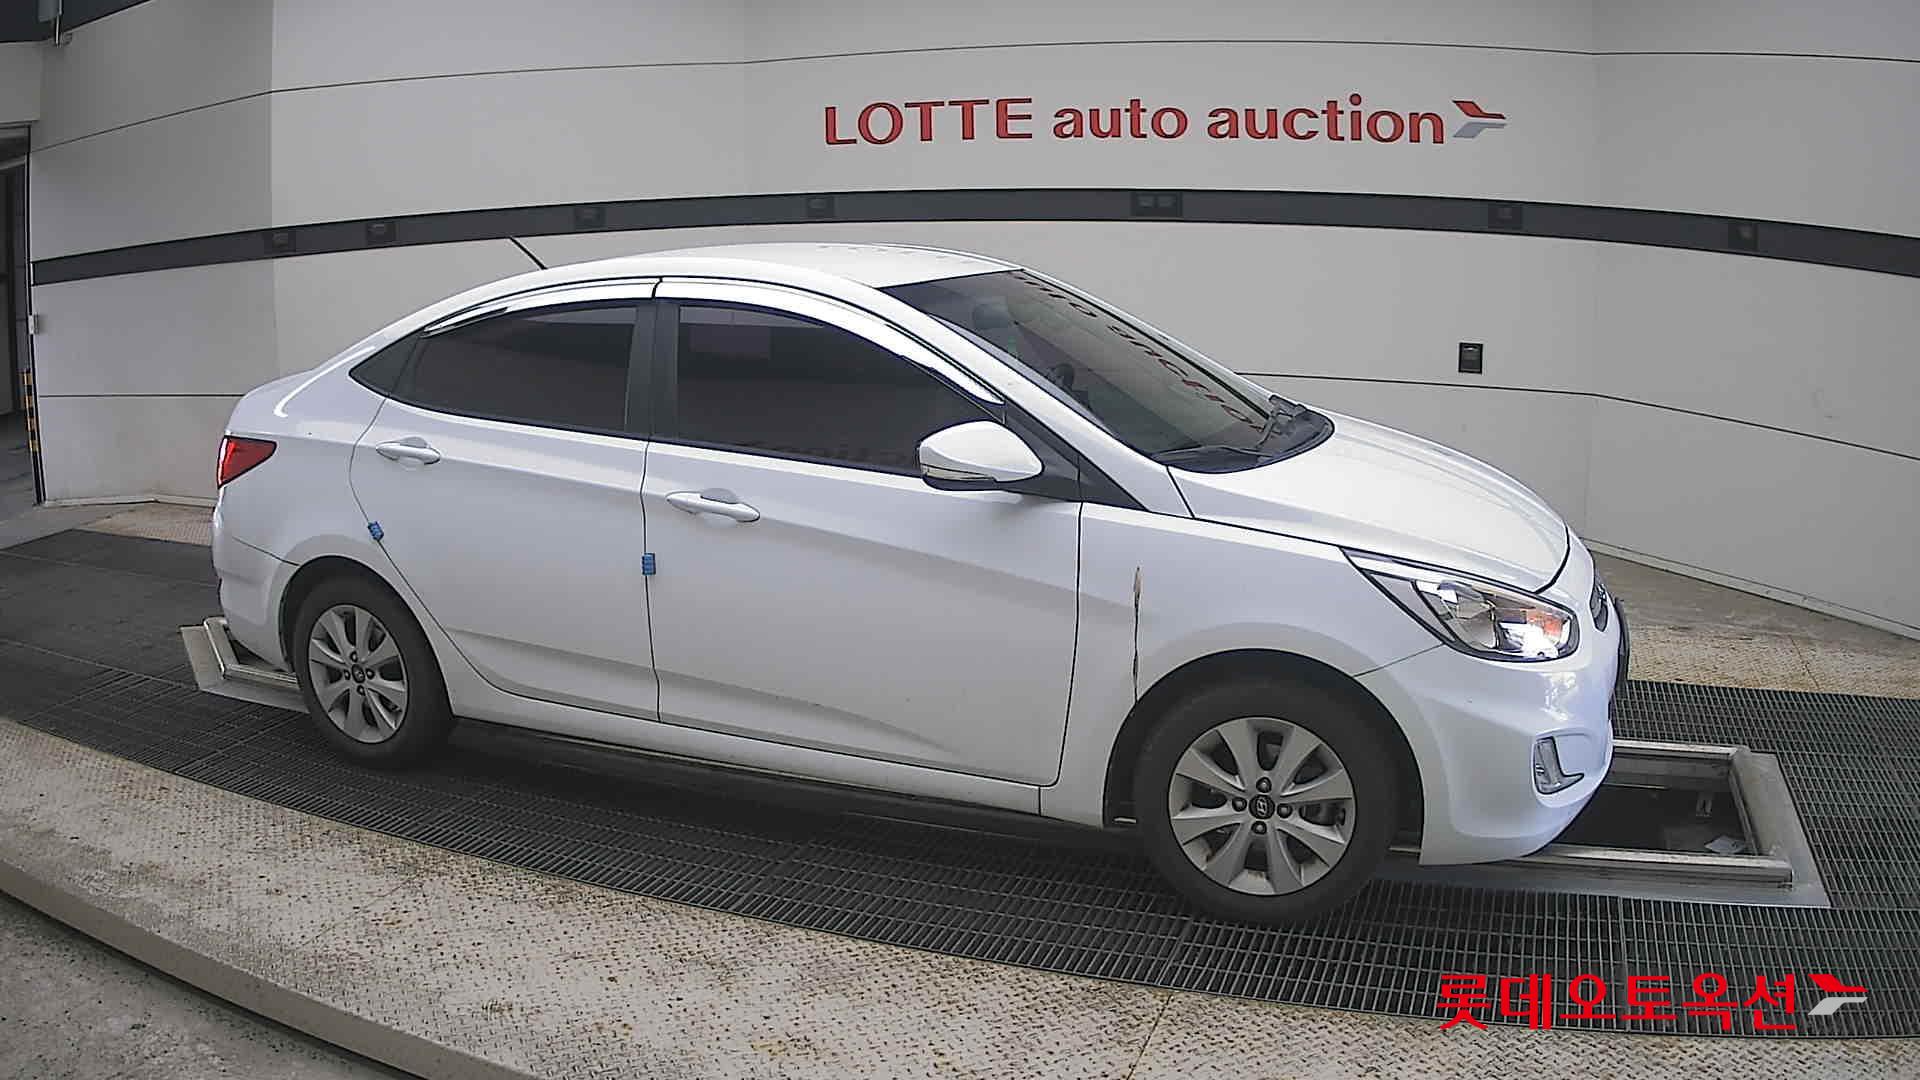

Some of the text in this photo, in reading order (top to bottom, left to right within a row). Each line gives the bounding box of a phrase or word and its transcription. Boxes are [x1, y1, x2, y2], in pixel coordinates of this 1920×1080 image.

[824, 93, 1444, 145] LOTTE auto auction
